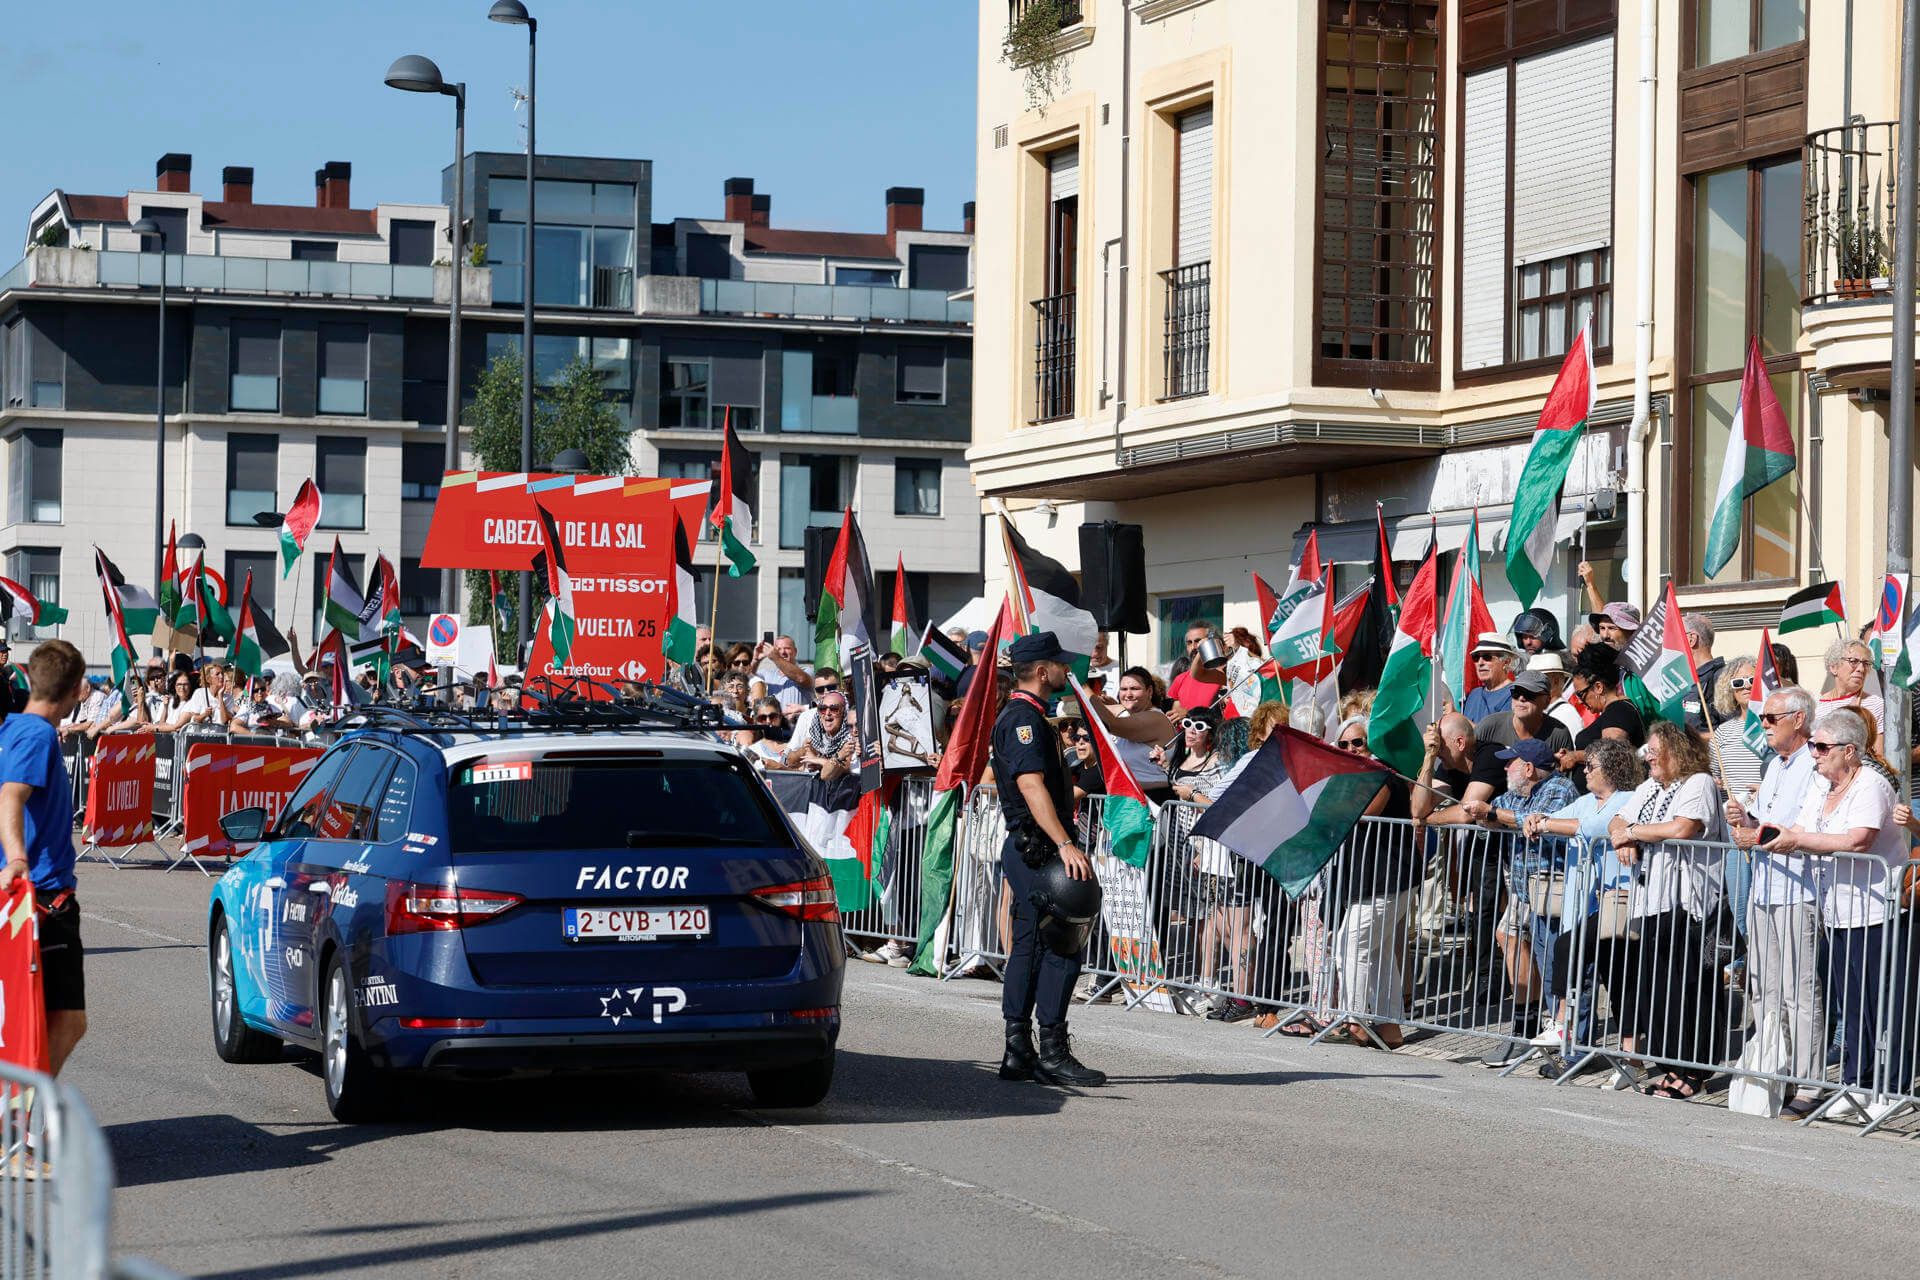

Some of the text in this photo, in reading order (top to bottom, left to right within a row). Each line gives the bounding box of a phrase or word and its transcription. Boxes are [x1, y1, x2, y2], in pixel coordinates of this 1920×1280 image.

[565, 522, 586, 546] DE
[591, 523, 611, 548] LA
[615, 523, 646, 549] SAL
[597, 579, 669, 593] TISSOT
[576, 618, 656, 637] VUELTA 25
[543, 662, 613, 677] Carrefour
[481, 769, 512, 781] 1111
[106, 779, 140, 811] LA VUELTA
[576, 864, 690, 891] FACTOR
[567, 924, 576, 935] B
[353, 984, 400, 1008] FANTINI
